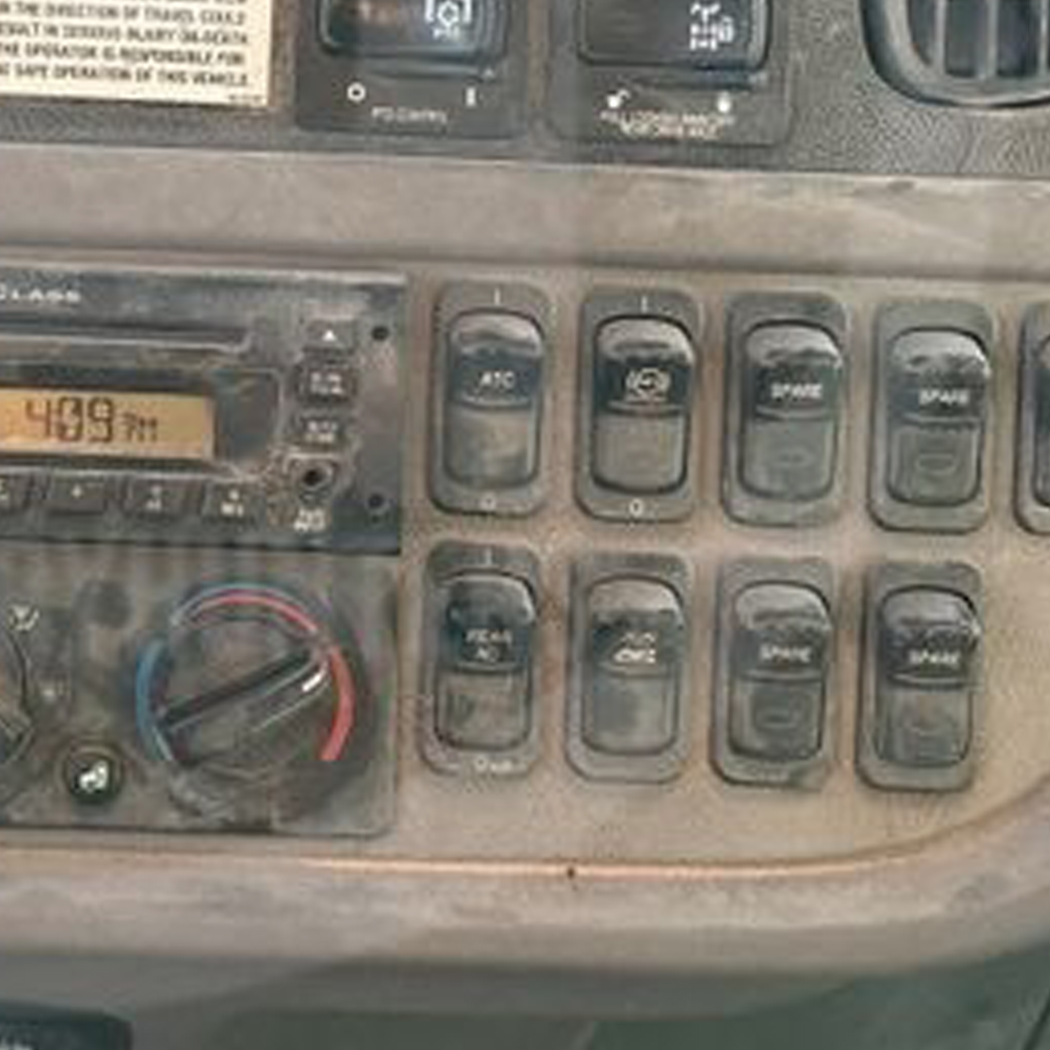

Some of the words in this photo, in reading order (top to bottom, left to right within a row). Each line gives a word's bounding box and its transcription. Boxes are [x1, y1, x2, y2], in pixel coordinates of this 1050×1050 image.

[771, 383, 823, 400] SPARE
[918, 388, 970, 406] SPARE
[760, 643, 812, 663] SPARE
[909, 650, 962, 668] SPARE
